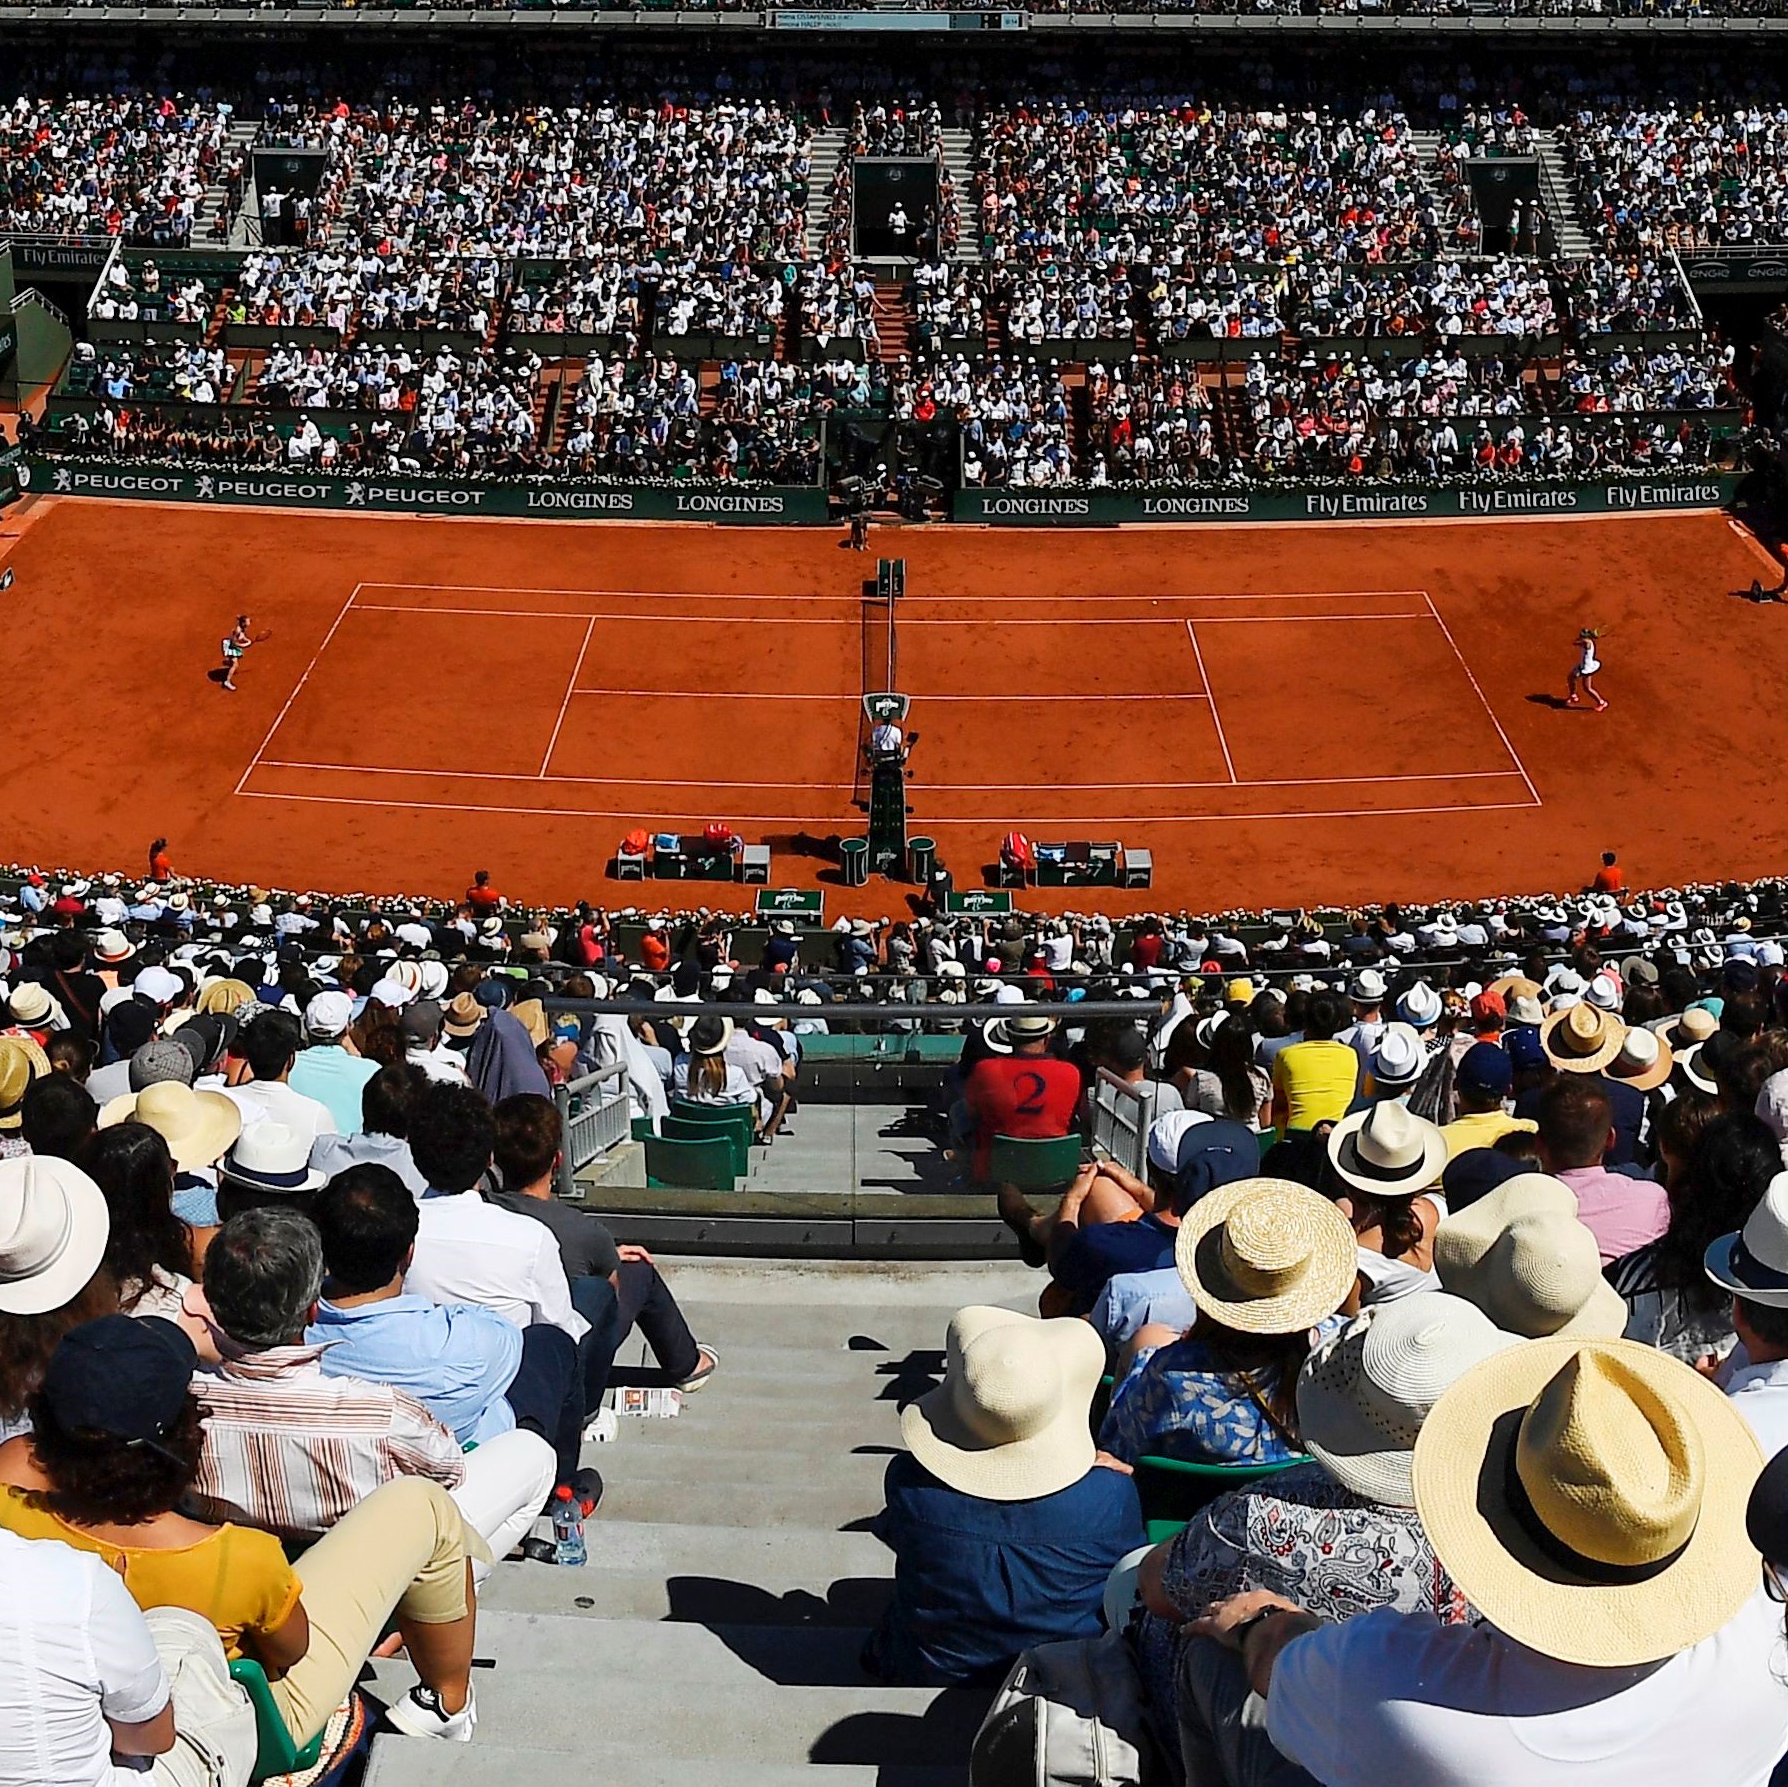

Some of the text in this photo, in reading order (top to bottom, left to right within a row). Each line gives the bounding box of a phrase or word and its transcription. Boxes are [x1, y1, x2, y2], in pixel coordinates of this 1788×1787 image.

[24, 249, 107, 265] Fly Emirates
[74, 473, 183, 492] PEUGEOT
[218, 480, 332, 499] PEUGEOT
[368, 487, 485, 505] PEUGEOT
[528, 491, 633, 510] LONGINES
[677, 494, 784, 513] LONGINES
[1143, 497, 1250, 514] LONGINES
[1306, 494, 1427, 517] Fly Emirates
[1459, 489, 1577, 513] Fly Emirates
[1607, 484, 1720, 508] Fly Emirates
[982, 498, 1089, 514] LONGINES
[1014, 1072, 1046, 1115] 2
